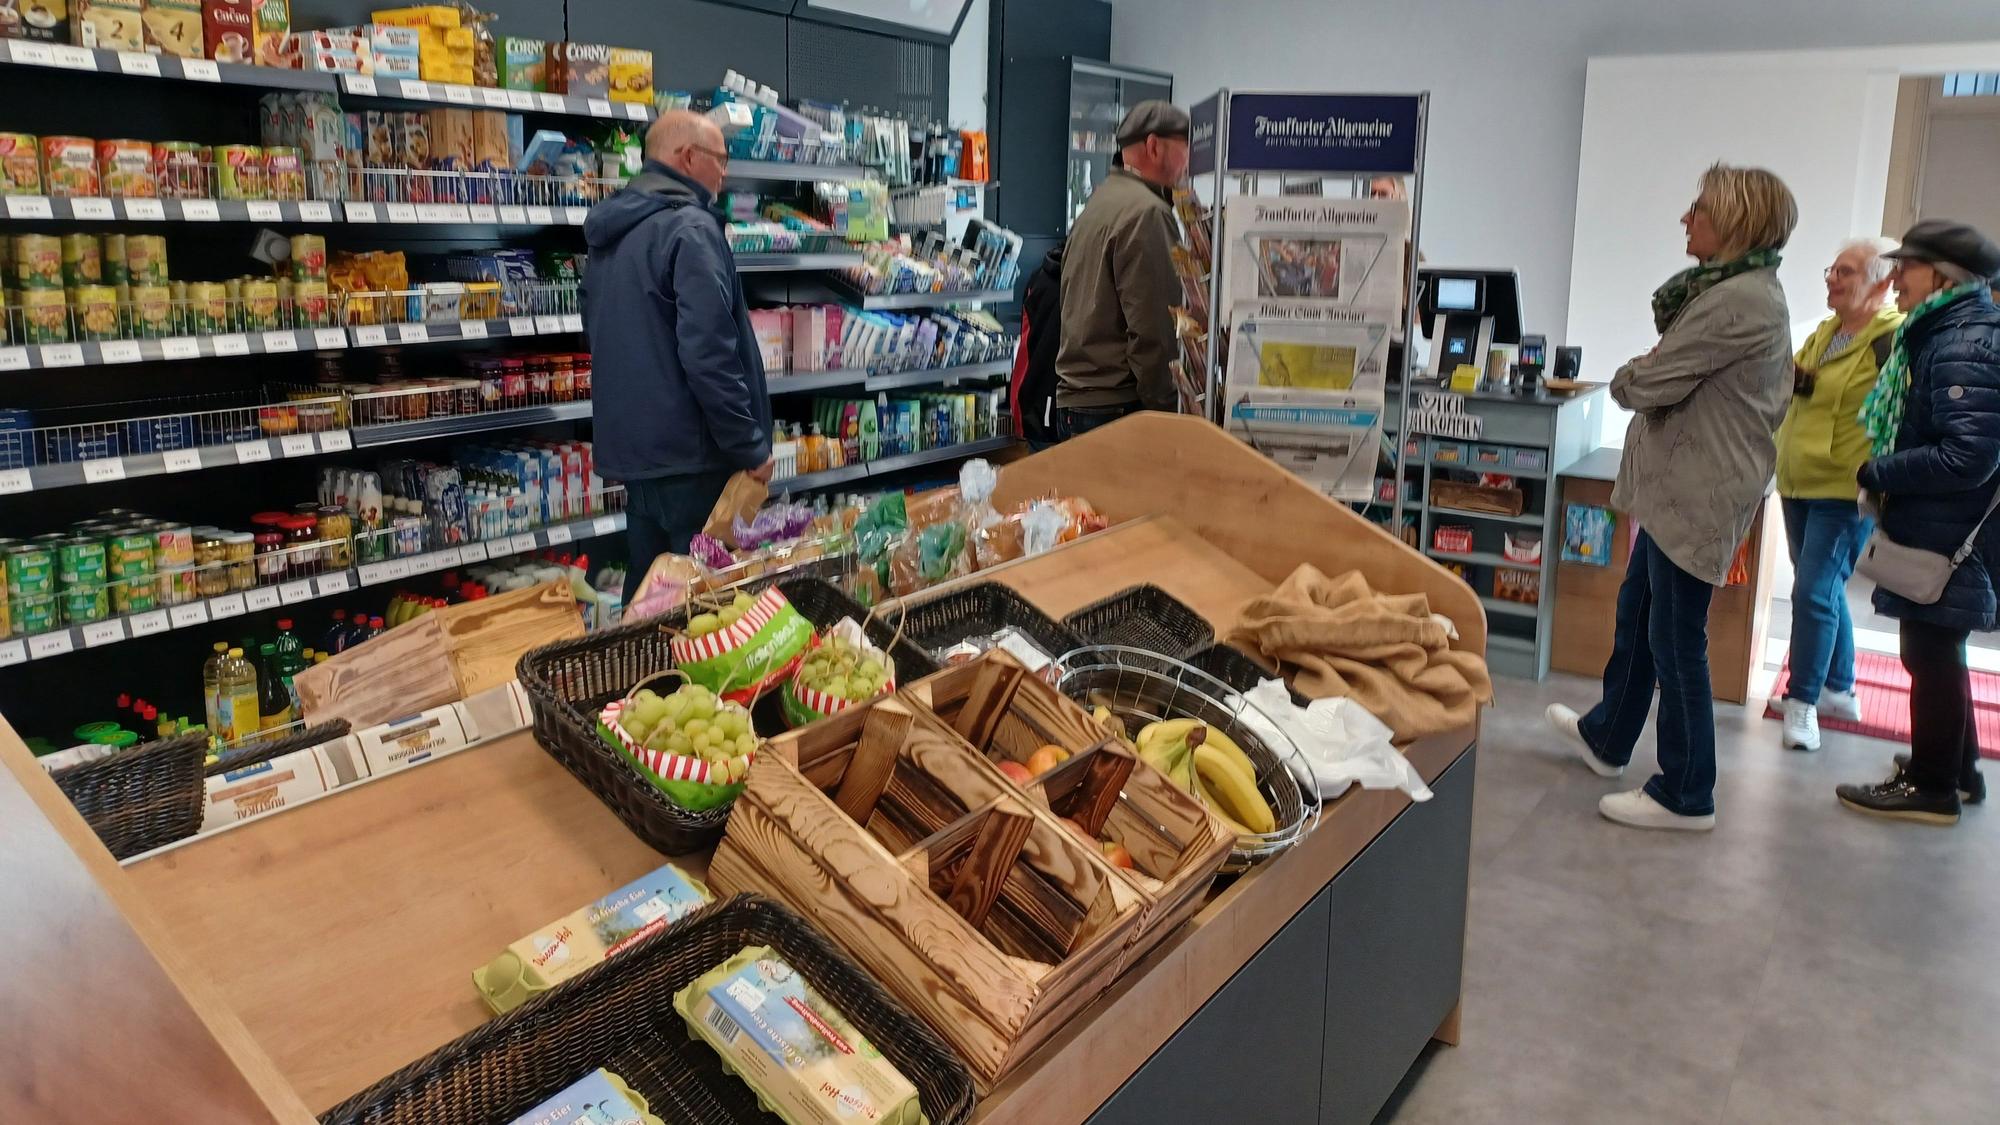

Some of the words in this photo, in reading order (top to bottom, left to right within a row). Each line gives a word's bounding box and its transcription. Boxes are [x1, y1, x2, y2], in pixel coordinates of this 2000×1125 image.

[110, 19, 124, 40] 2
[169, 20, 185, 41] 4
[506, 37, 545, 55] CORNY
[566, 42, 607, 62] CORNY
[1255, 115, 1325, 139] Frankfurter
[1326, 116, 1393, 140] Allgemeine
[1254, 204, 1316, 223] Frankfurter
[1316, 206, 1379, 226] Allgemeine
[234, 796, 286, 820] RUSTIKAL
[766, 1026, 796, 1058] frische
[549, 1102, 573, 1121] Eier
